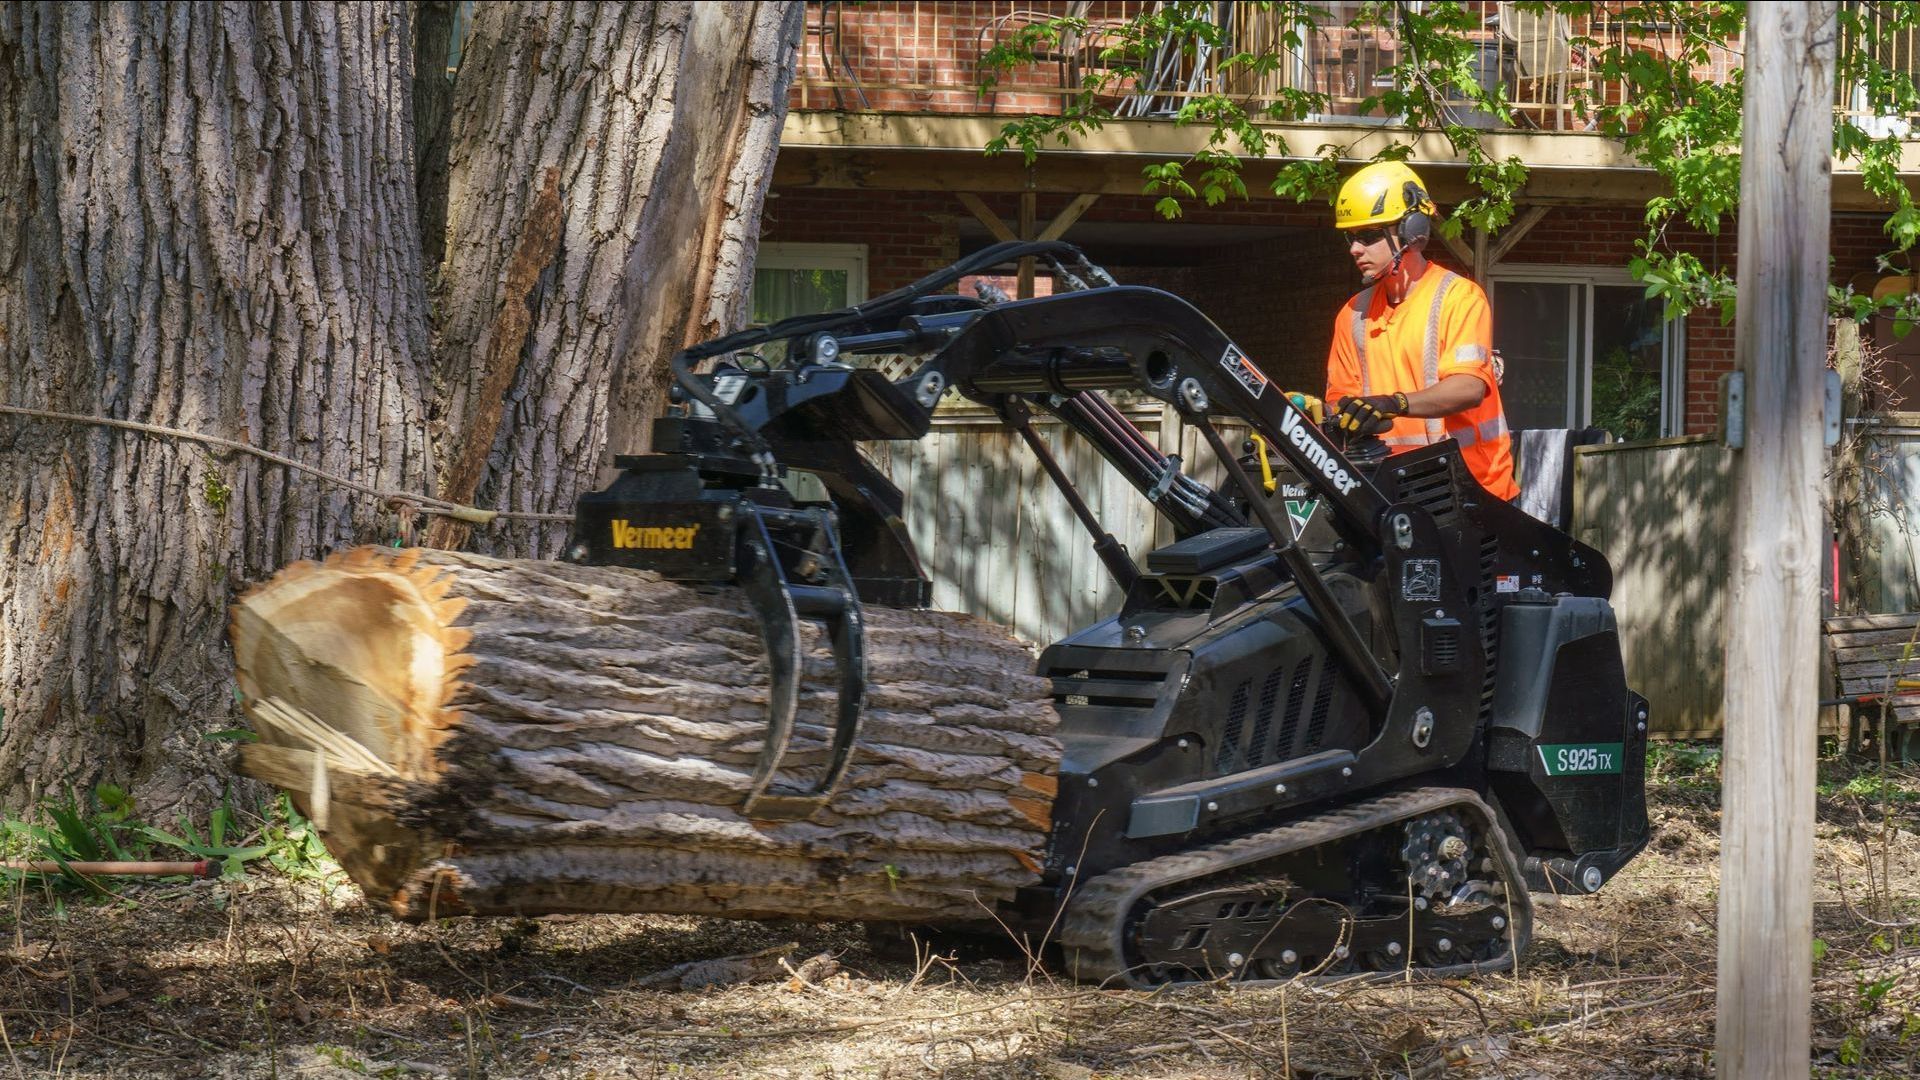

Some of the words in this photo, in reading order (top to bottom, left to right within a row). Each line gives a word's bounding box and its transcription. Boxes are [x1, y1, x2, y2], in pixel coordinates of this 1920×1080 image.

[1280, 405, 1358, 496] Vermeer
[1282, 484, 1307, 497] Verm
[611, 519, 697, 549] Vermeer
